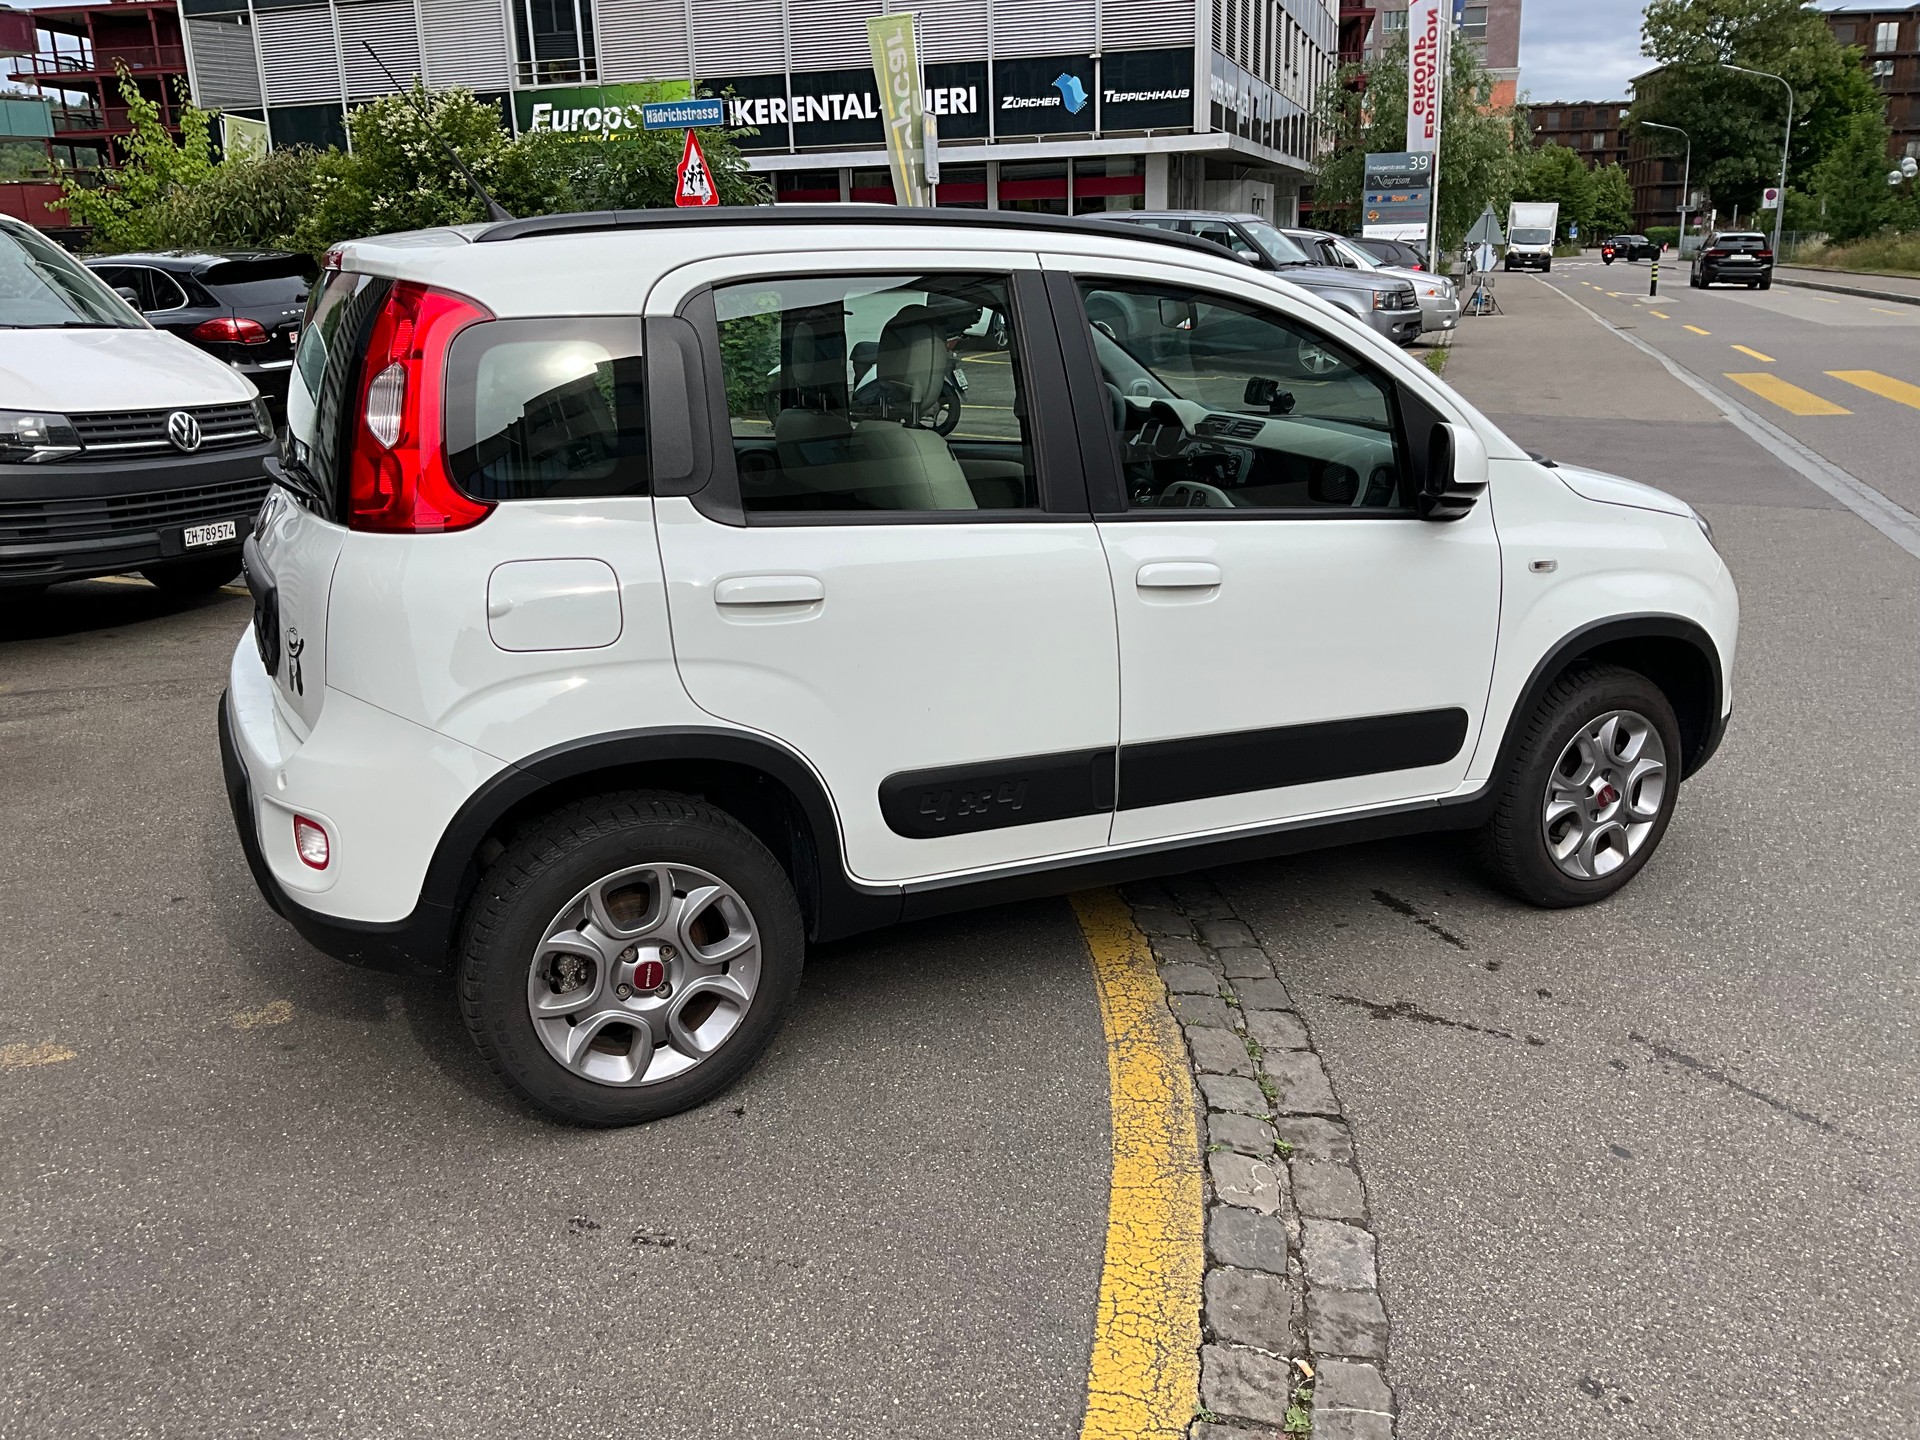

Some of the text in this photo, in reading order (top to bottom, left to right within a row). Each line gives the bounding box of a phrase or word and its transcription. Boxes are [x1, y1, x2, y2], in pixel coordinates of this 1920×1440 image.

[1001, 88, 1190, 109] ZÜRCHER TEPPICHHAUS
[645, 107, 719, 124] Hädrichstrasse
[1408, 155, 1429, 171] 39
